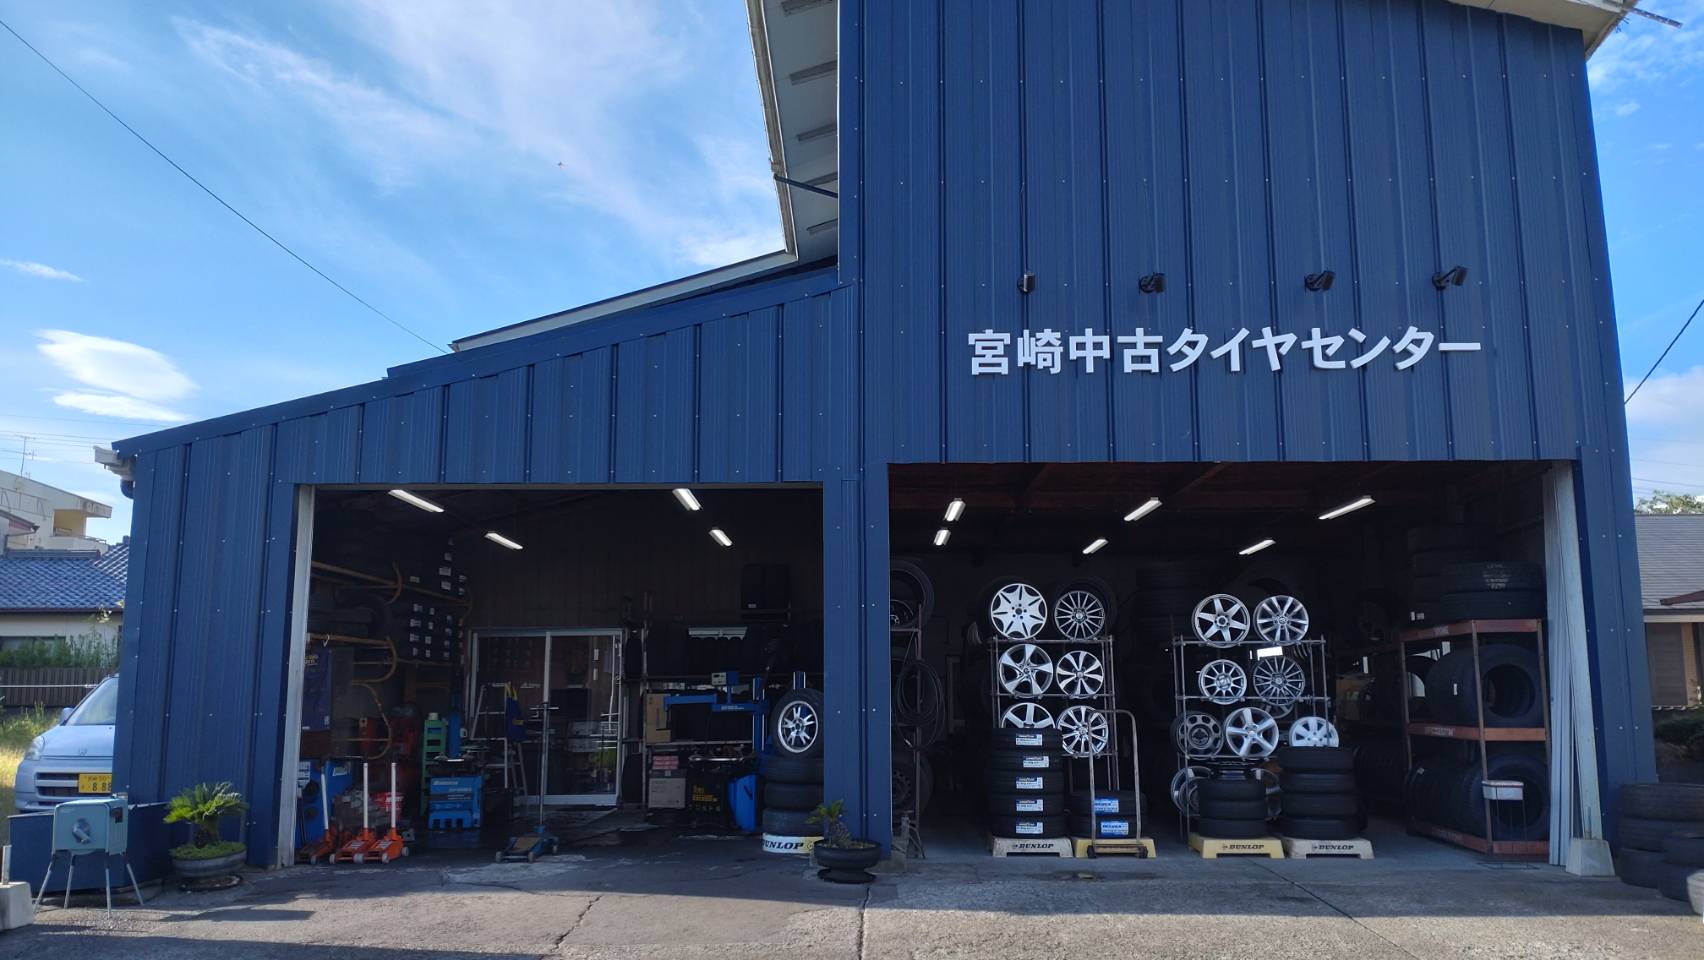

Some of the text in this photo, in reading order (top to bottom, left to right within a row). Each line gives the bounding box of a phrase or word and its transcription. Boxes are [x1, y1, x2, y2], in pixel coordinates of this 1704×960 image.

[967, 326, 1482, 375] 宮崎中古タイヤセンター
